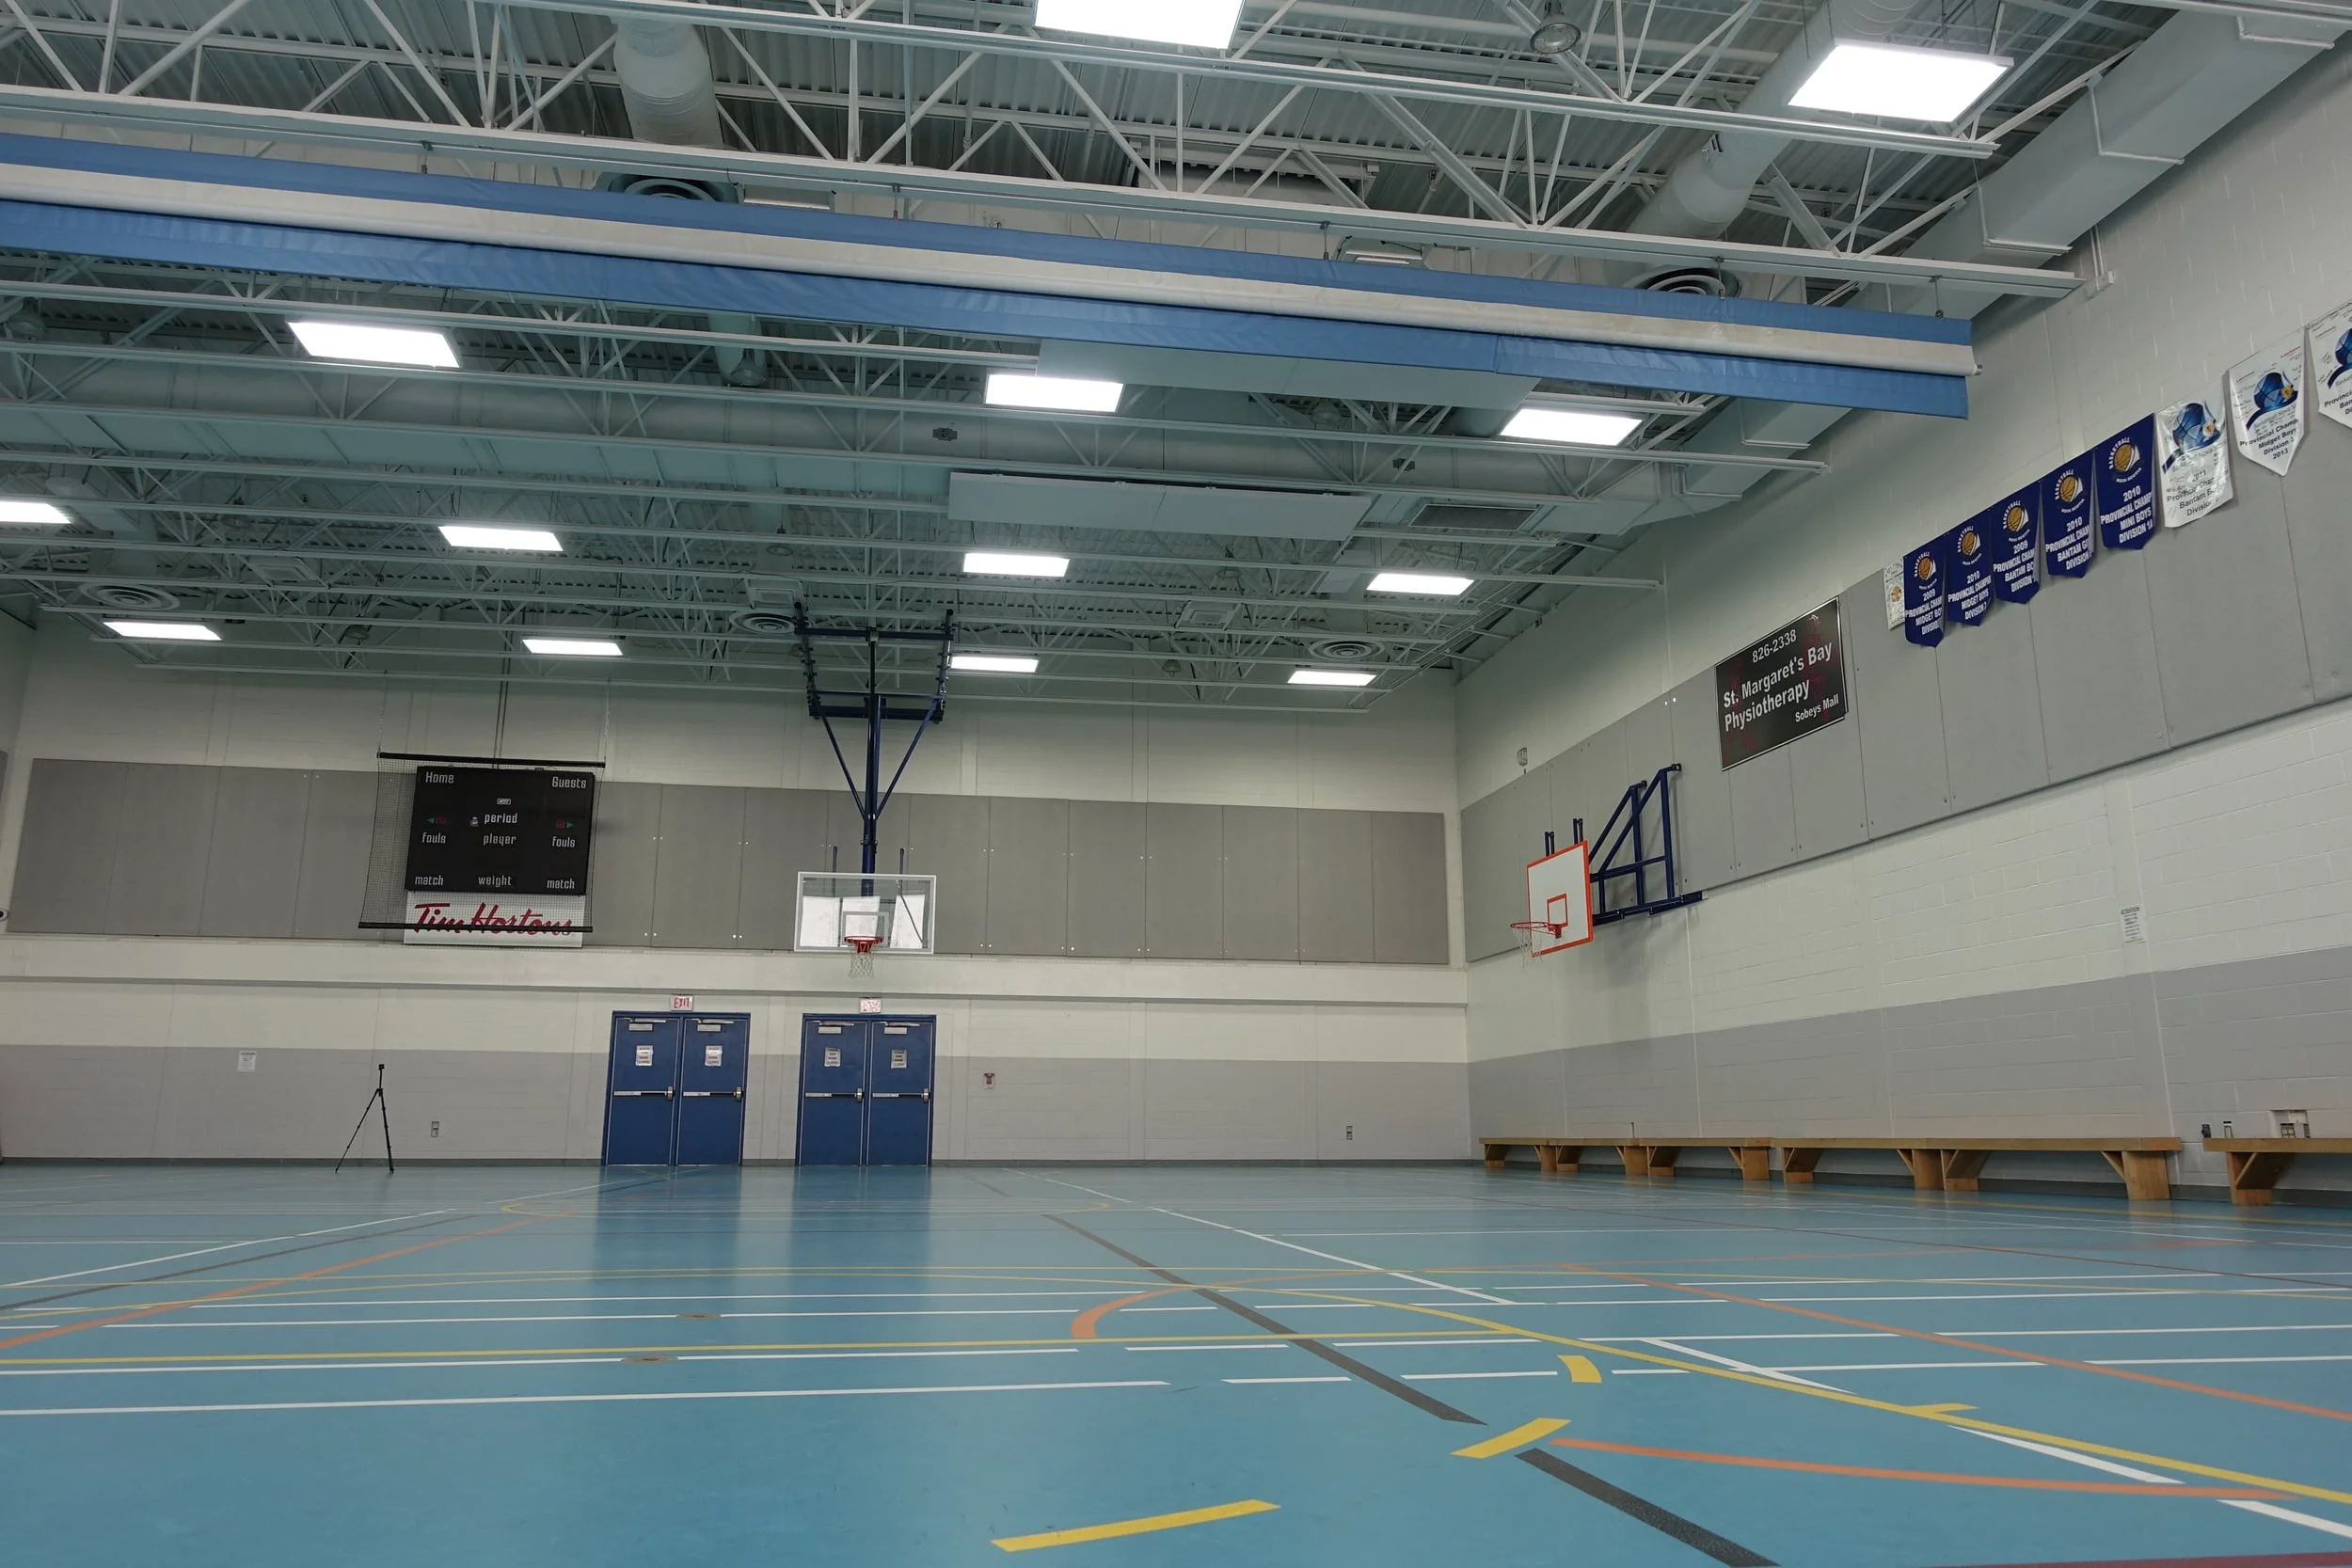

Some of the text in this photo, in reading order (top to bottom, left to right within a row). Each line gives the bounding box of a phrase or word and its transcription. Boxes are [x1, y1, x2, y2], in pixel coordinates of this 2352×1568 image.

[2239, 430, 2274, 446] Provincial
[2258, 436, 2280, 450] Midget
[2108, 436, 2131, 470] BASKETBALL
[2264, 440, 2289, 455] Division
[2272, 448, 2289, 459] 2013
[2122, 485, 2141, 502] 2010
[2179, 493, 2206, 509] Bantam
[2100, 502, 2134, 525] PROVINCIAL
[2120, 506, 2152, 531] MINI BOYS
[2066, 516, 2082, 532] 2010
[2045, 532, 2076, 553] PROVINCIAL
[2119, 525, 2146, 544] DIVISION
[2013, 540, 2028, 554] 2009
[2058, 543, 2082, 562] BANTAM
[1993, 555, 2022, 573] PROVINCIAL
[2066, 551, 2089, 570] DIVISION
[1966, 570, 1980, 584] 2010
[2005, 565, 2026, 582] BANTAM
[2010, 575, 2032, 593] DIVISION
[1947, 585, 1976, 603] PROVINCIAL
[1961, 594, 1979, 610] MIDGET
[1905, 603, 1931, 618] PROVINCIAL
[1964, 603, 1983, 620] DIVISION
[1752, 629, 1797, 663] 826-2338
[1724, 642, 1833, 708] St. Margaret's Bay
[1724, 679, 1810, 732] Physiotherapy
[1795, 693, 1839, 722] Sobeys Mall
[425, 771, 454, 784] Home
[551, 776, 587, 789] Guests
[484, 813, 518, 824] period
[421, 832, 447, 844] fouls
[483, 832, 516, 846] player
[552, 836, 576, 847] fouls
[414, 875, 444, 886] match
[478, 875, 512, 887] weight
[547, 879, 575, 890] match
[414, 902, 573, 936] Tim Hortons
